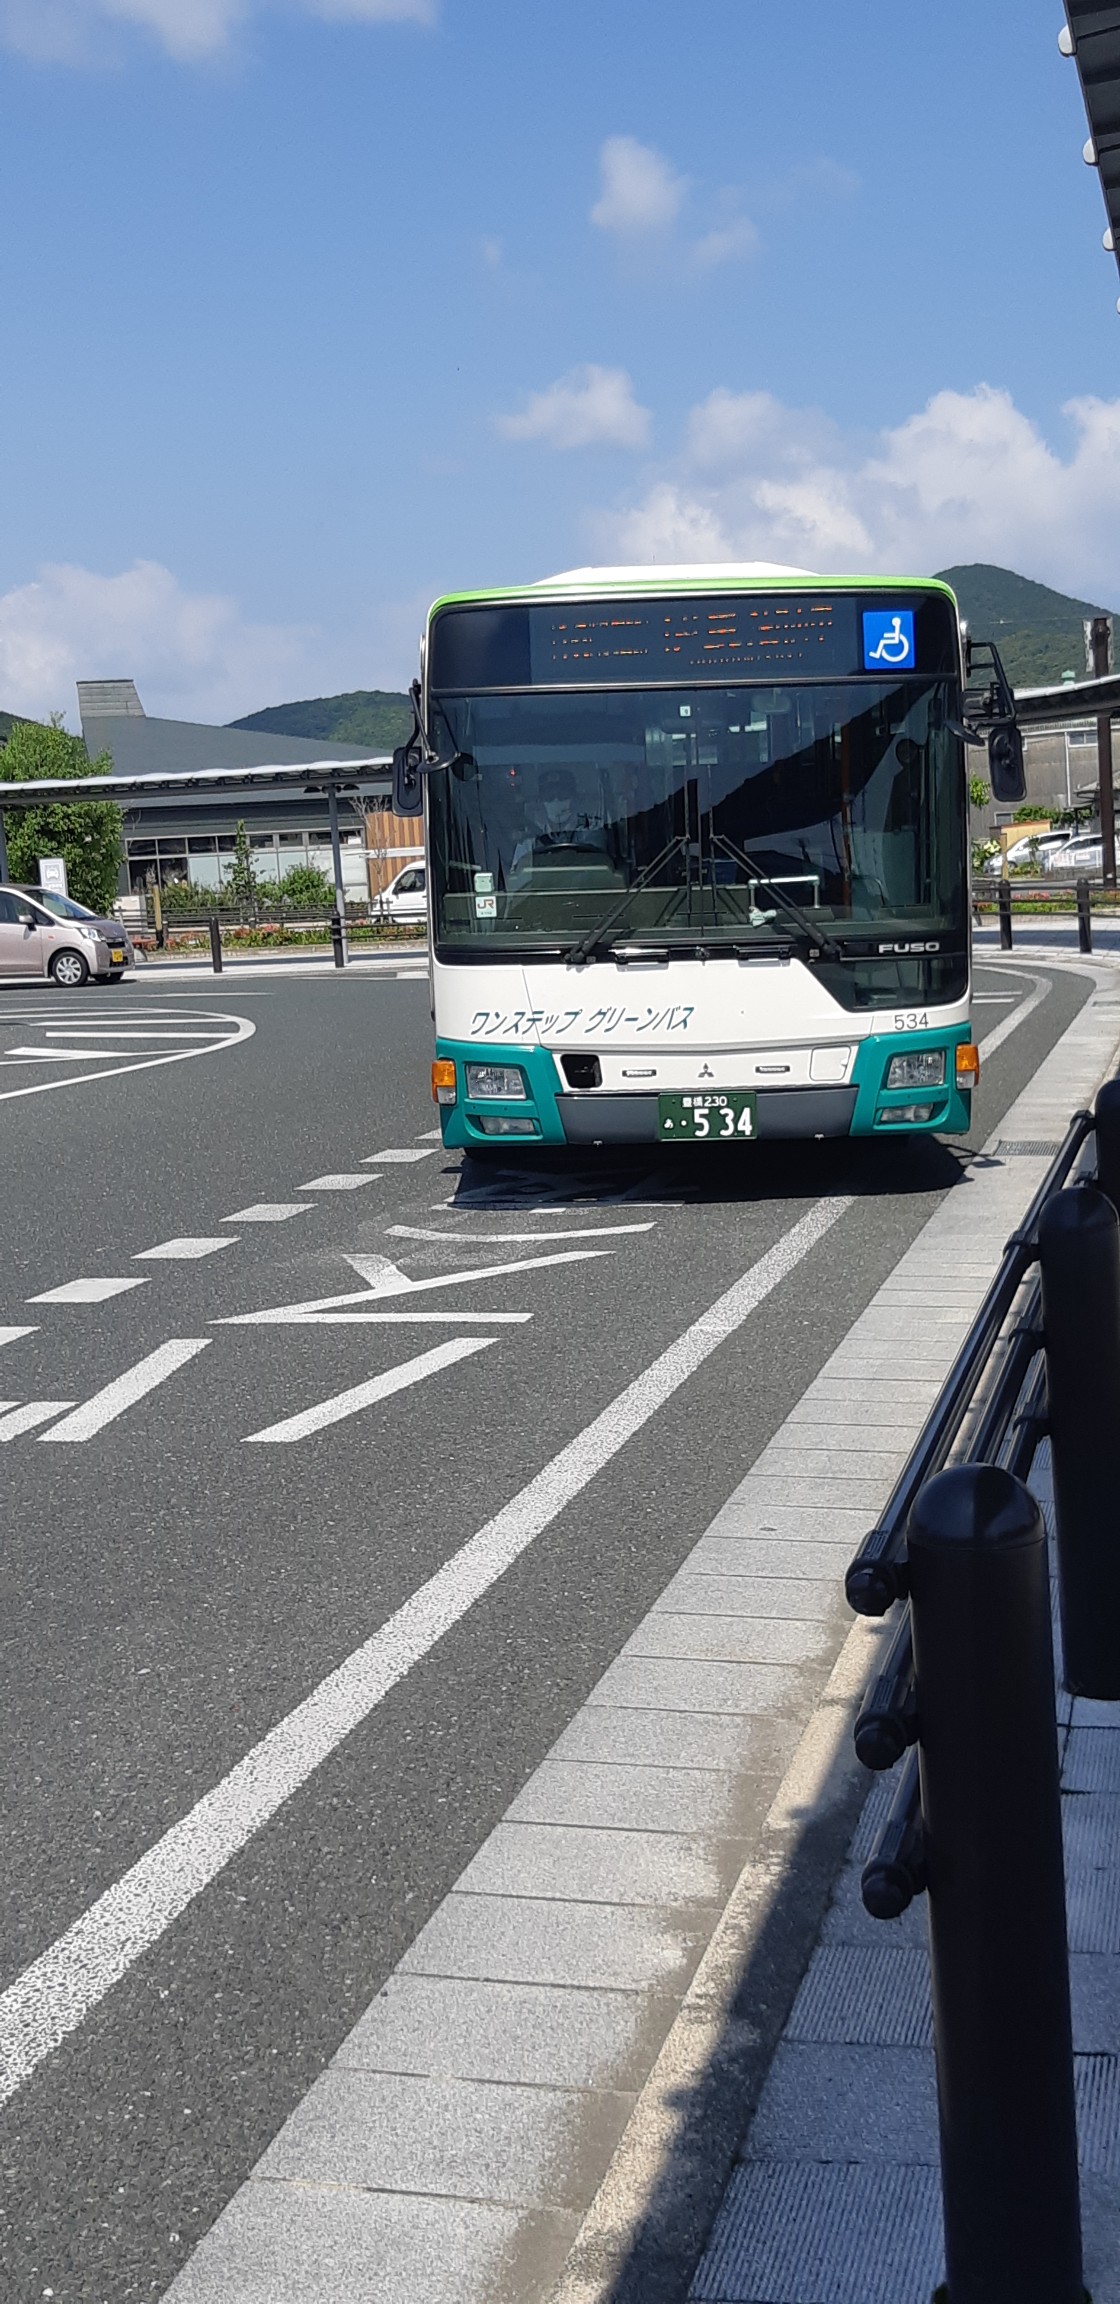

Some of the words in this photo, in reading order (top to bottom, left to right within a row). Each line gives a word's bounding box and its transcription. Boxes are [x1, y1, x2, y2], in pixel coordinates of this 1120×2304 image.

[477, 899, 494, 909] JR
[879, 942, 940, 954] FUSO
[471, 1008, 583, 1035] ワンステップ
[584, 1005, 695, 1033] グリーンバス
[894, 1012, 929, 1030] 534
